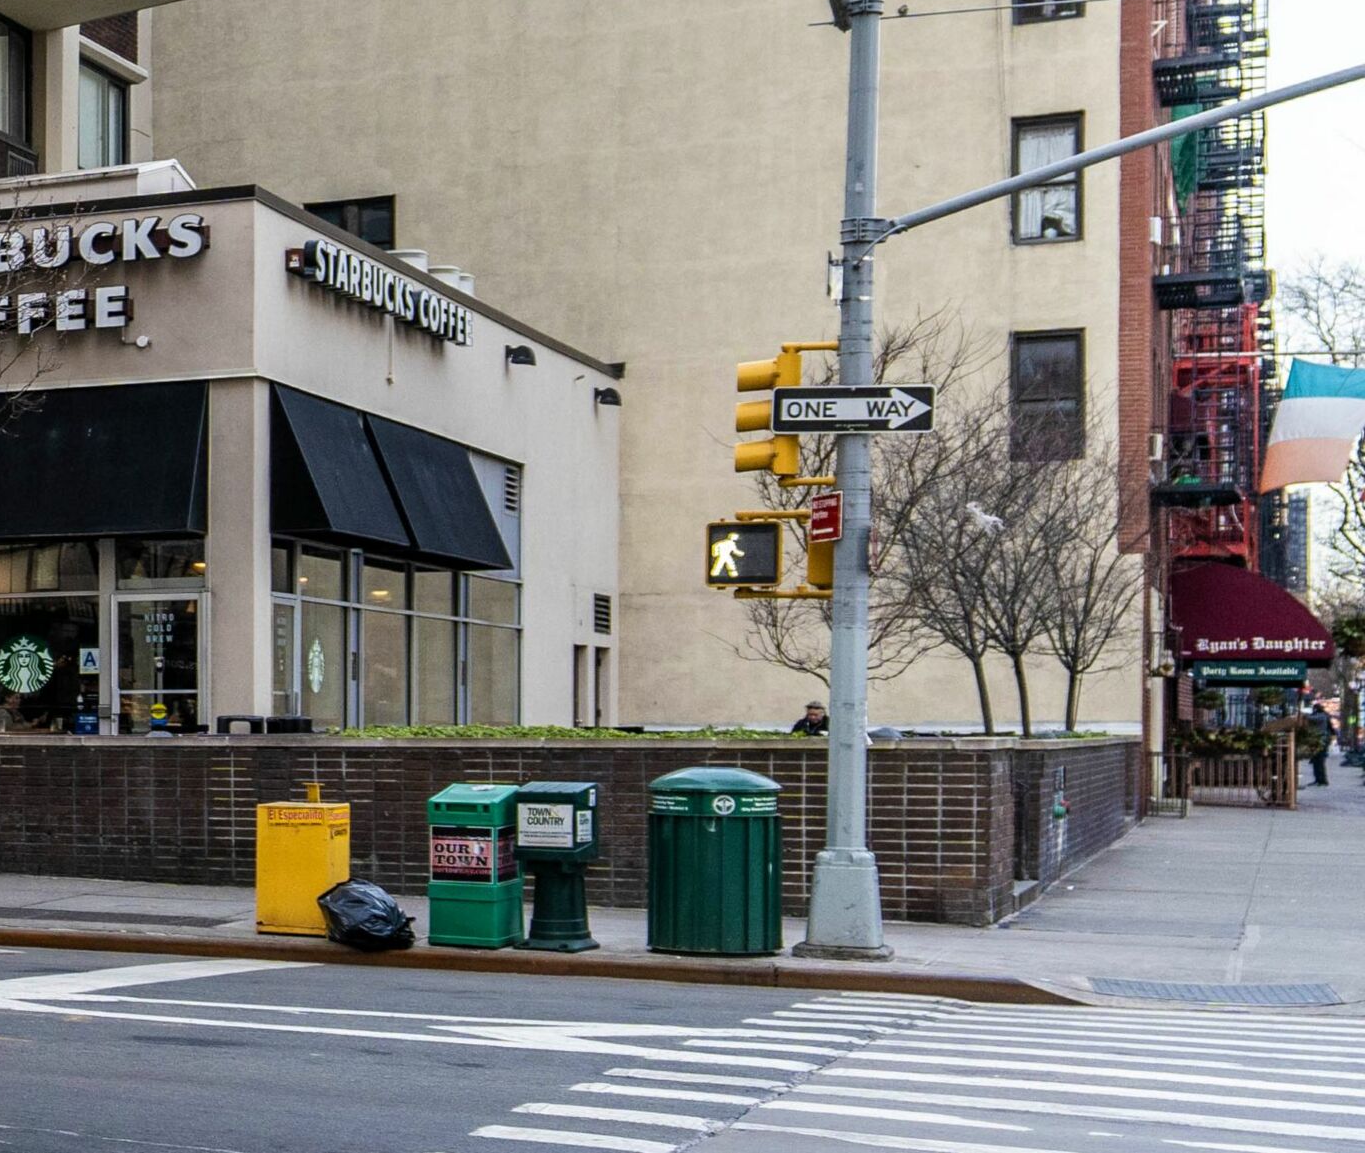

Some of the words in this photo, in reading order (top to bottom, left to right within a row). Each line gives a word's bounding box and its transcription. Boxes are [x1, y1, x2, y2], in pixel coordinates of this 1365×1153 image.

[315, 239, 414, 321] STARBUCKS
[420, 290, 474, 345] COFFEE
[787, 401, 837, 418] ONE
[867, 401, 915, 417] WAY
[145, 614, 174, 622] NITRO
[147, 624, 172, 632] COLD
[146, 635, 173, 643] BREW
[1197, 638, 1247, 652] Ryan's
[1252, 637, 1326, 653] Daughter
[84, 652, 96, 666] A
[269, 809, 277, 820] El
[527, 808, 551, 816] TOWN
[527, 816, 565, 825] COUNTRY
[434, 843, 470, 854] OUR
[434, 855, 488, 866] TOWN
